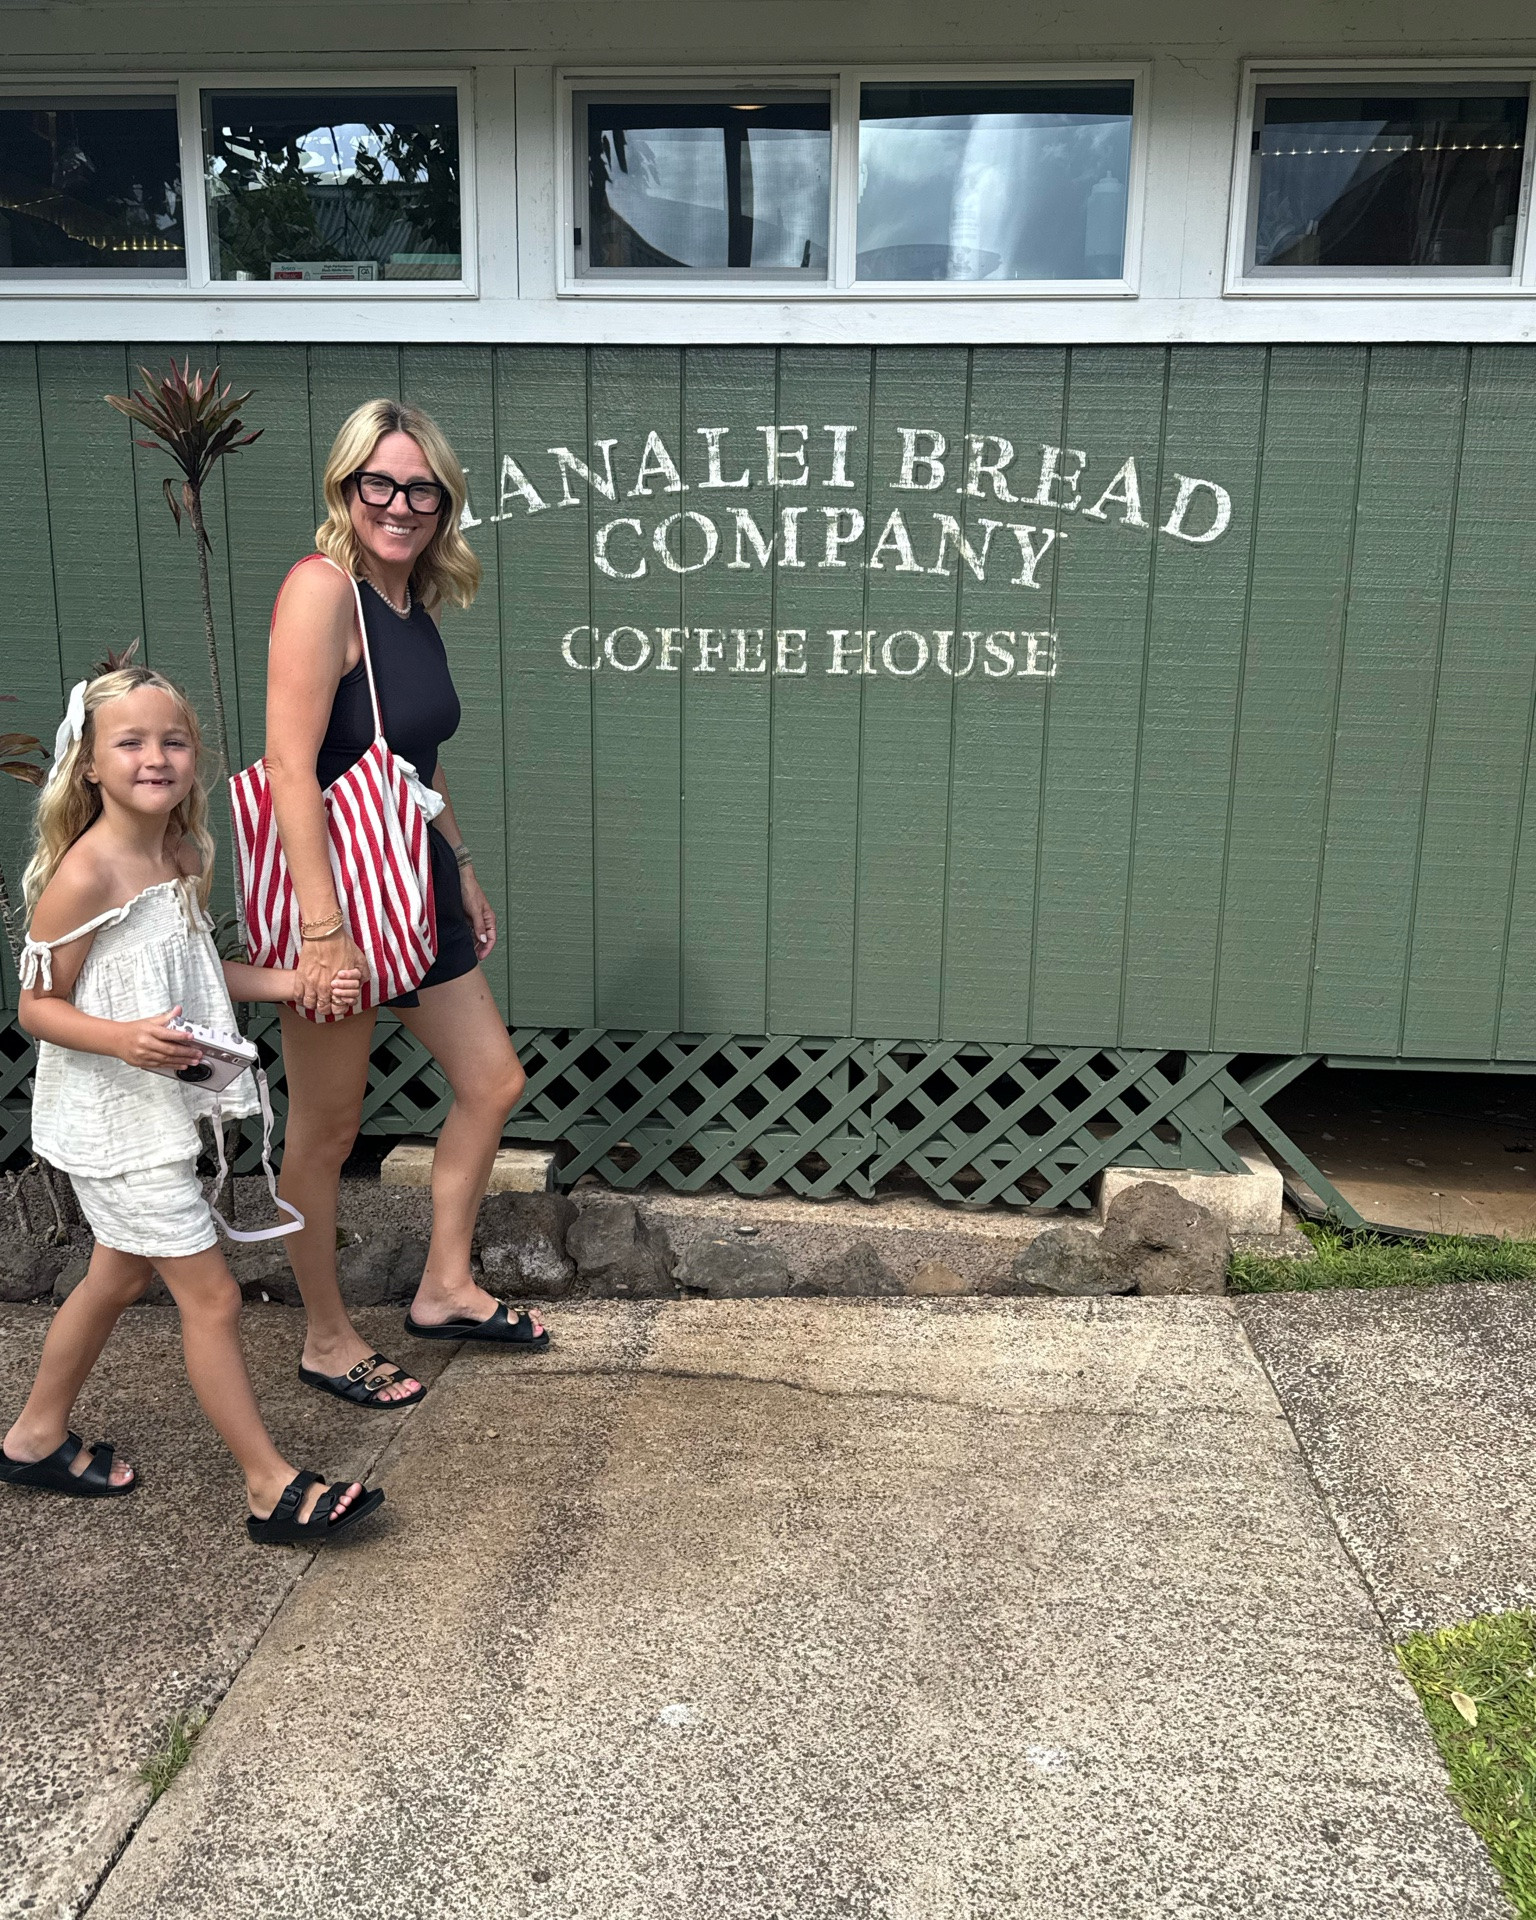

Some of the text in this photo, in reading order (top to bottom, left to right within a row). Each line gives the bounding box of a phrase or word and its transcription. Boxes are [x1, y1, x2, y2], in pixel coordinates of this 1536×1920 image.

[890, 426, 1232, 543] BREAD
[593, 506, 1069, 590] COMPANY
[560, 625, 1059, 678] COFFEE HOUSE
